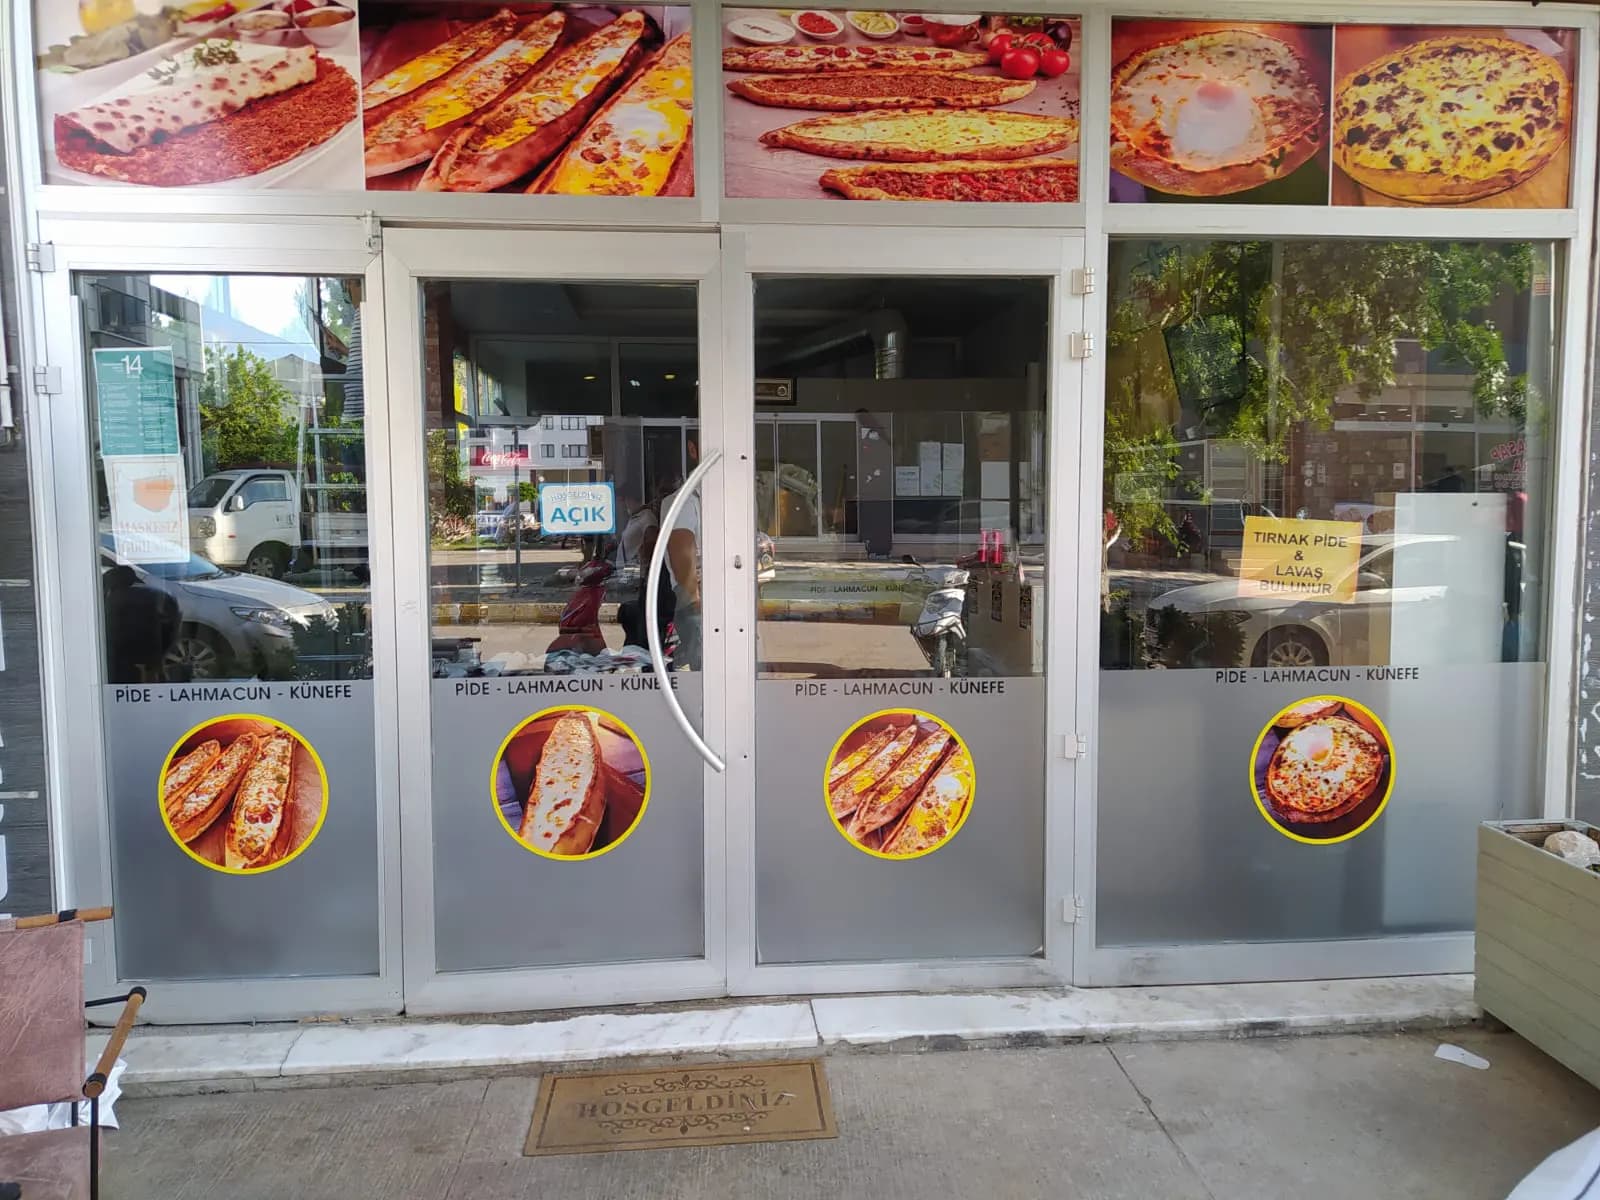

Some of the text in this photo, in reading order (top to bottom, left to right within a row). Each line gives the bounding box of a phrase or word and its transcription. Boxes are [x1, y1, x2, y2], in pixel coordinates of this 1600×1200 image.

[121, 354, 144, 375] 14
[551, 506, 606, 526] AÇIK
[1254, 532, 1349, 548] TIRNAK PİDE
[1294, 550, 1304, 561] &
[1276, 565, 1324, 582] LAVAŞ
[833, 582, 879, 593] LAHMACUN
[1260, 580, 1332, 594] BULUNUR
[1216, 668, 1247, 683] PİDE
[1263, 669, 1350, 683] LAHMACUN
[1366, 665, 1419, 681] KÜNEFE
[116, 686, 151, 703] PİDE
[169, 686, 271, 701] LAHMACUN
[289, 683, 352, 699] KÜNEFE
[455, 679, 490, 696] PİDE
[508, 679, 603, 695] LAHMACUN
[621, 675, 678, 691] KÜNEE
[795, 680, 827, 696] PİDE
[843, 682, 933, 696] LAHMACUN
[950, 678, 1005, 694] KÜNEFE
